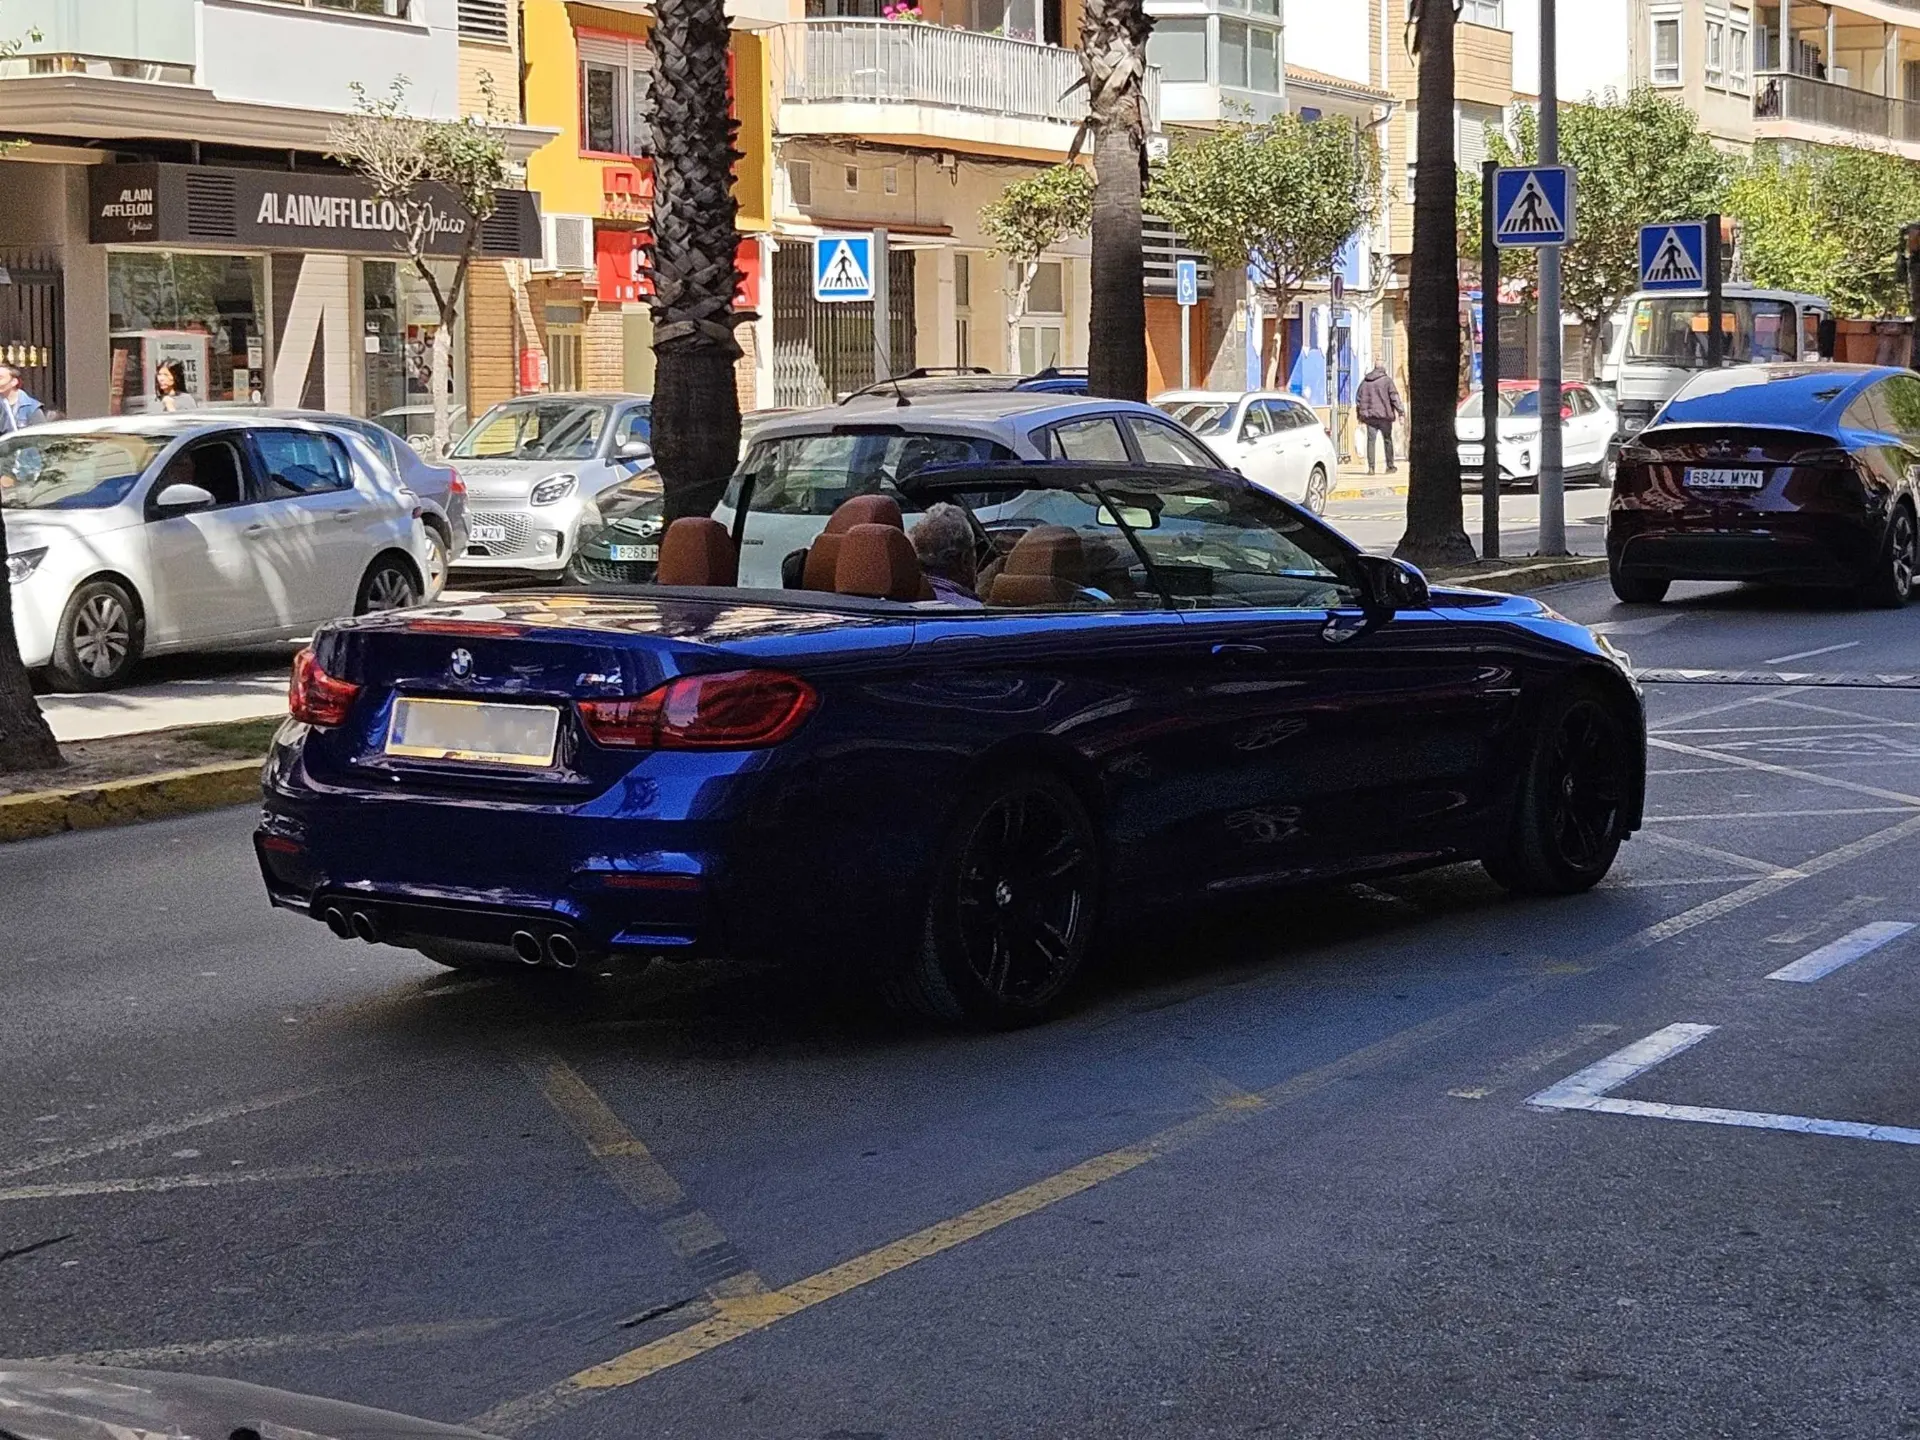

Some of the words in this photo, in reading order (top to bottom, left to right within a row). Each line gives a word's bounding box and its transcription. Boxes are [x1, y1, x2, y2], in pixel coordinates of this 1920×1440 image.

[120, 188, 152, 202] ALAIN
[101, 203, 153, 217] AFFLELOU
[1692, 471, 1725, 484] 6844
[1731, 472, 1758, 484] MYN
[619, 547, 647, 559] 8268
